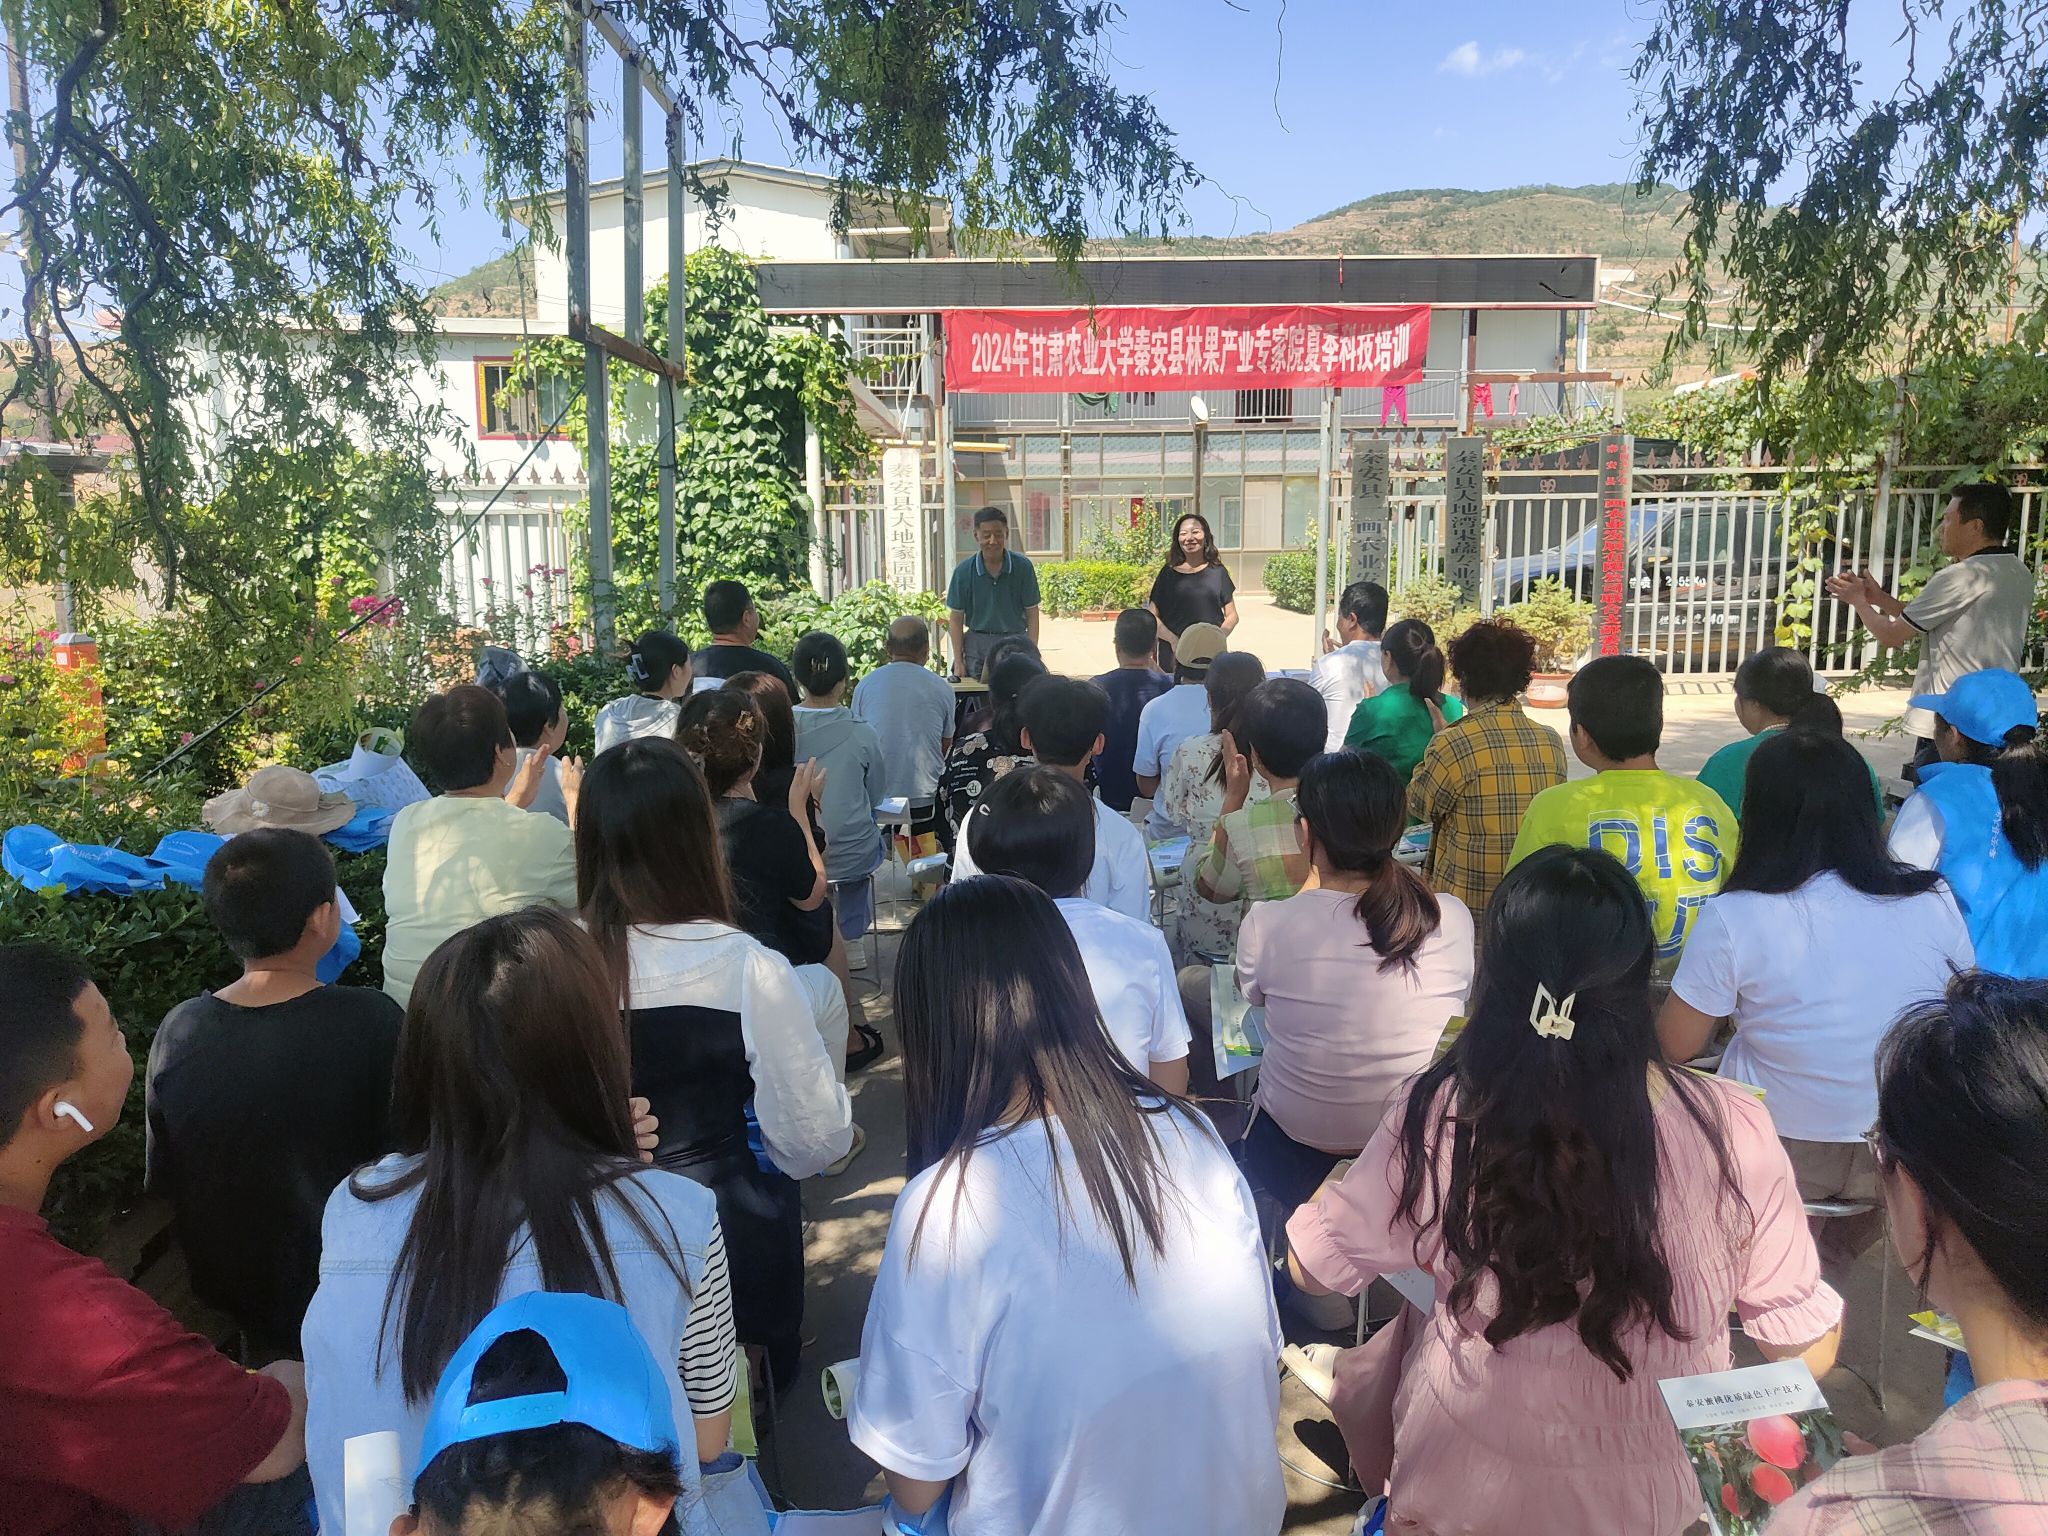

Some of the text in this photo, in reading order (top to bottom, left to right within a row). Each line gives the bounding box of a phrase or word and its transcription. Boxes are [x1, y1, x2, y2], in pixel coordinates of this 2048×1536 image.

[971, 322, 1410, 378] 2024年甘肃农业大学秦安县林果产业专家院夏季科技培训
[888, 462, 916, 592] 秦安县大地家园果
[1588, 806, 1722, 883] DIS
[1685, 1383, 1803, 1409] 秦安蜜桃优质绿色丰产技术
